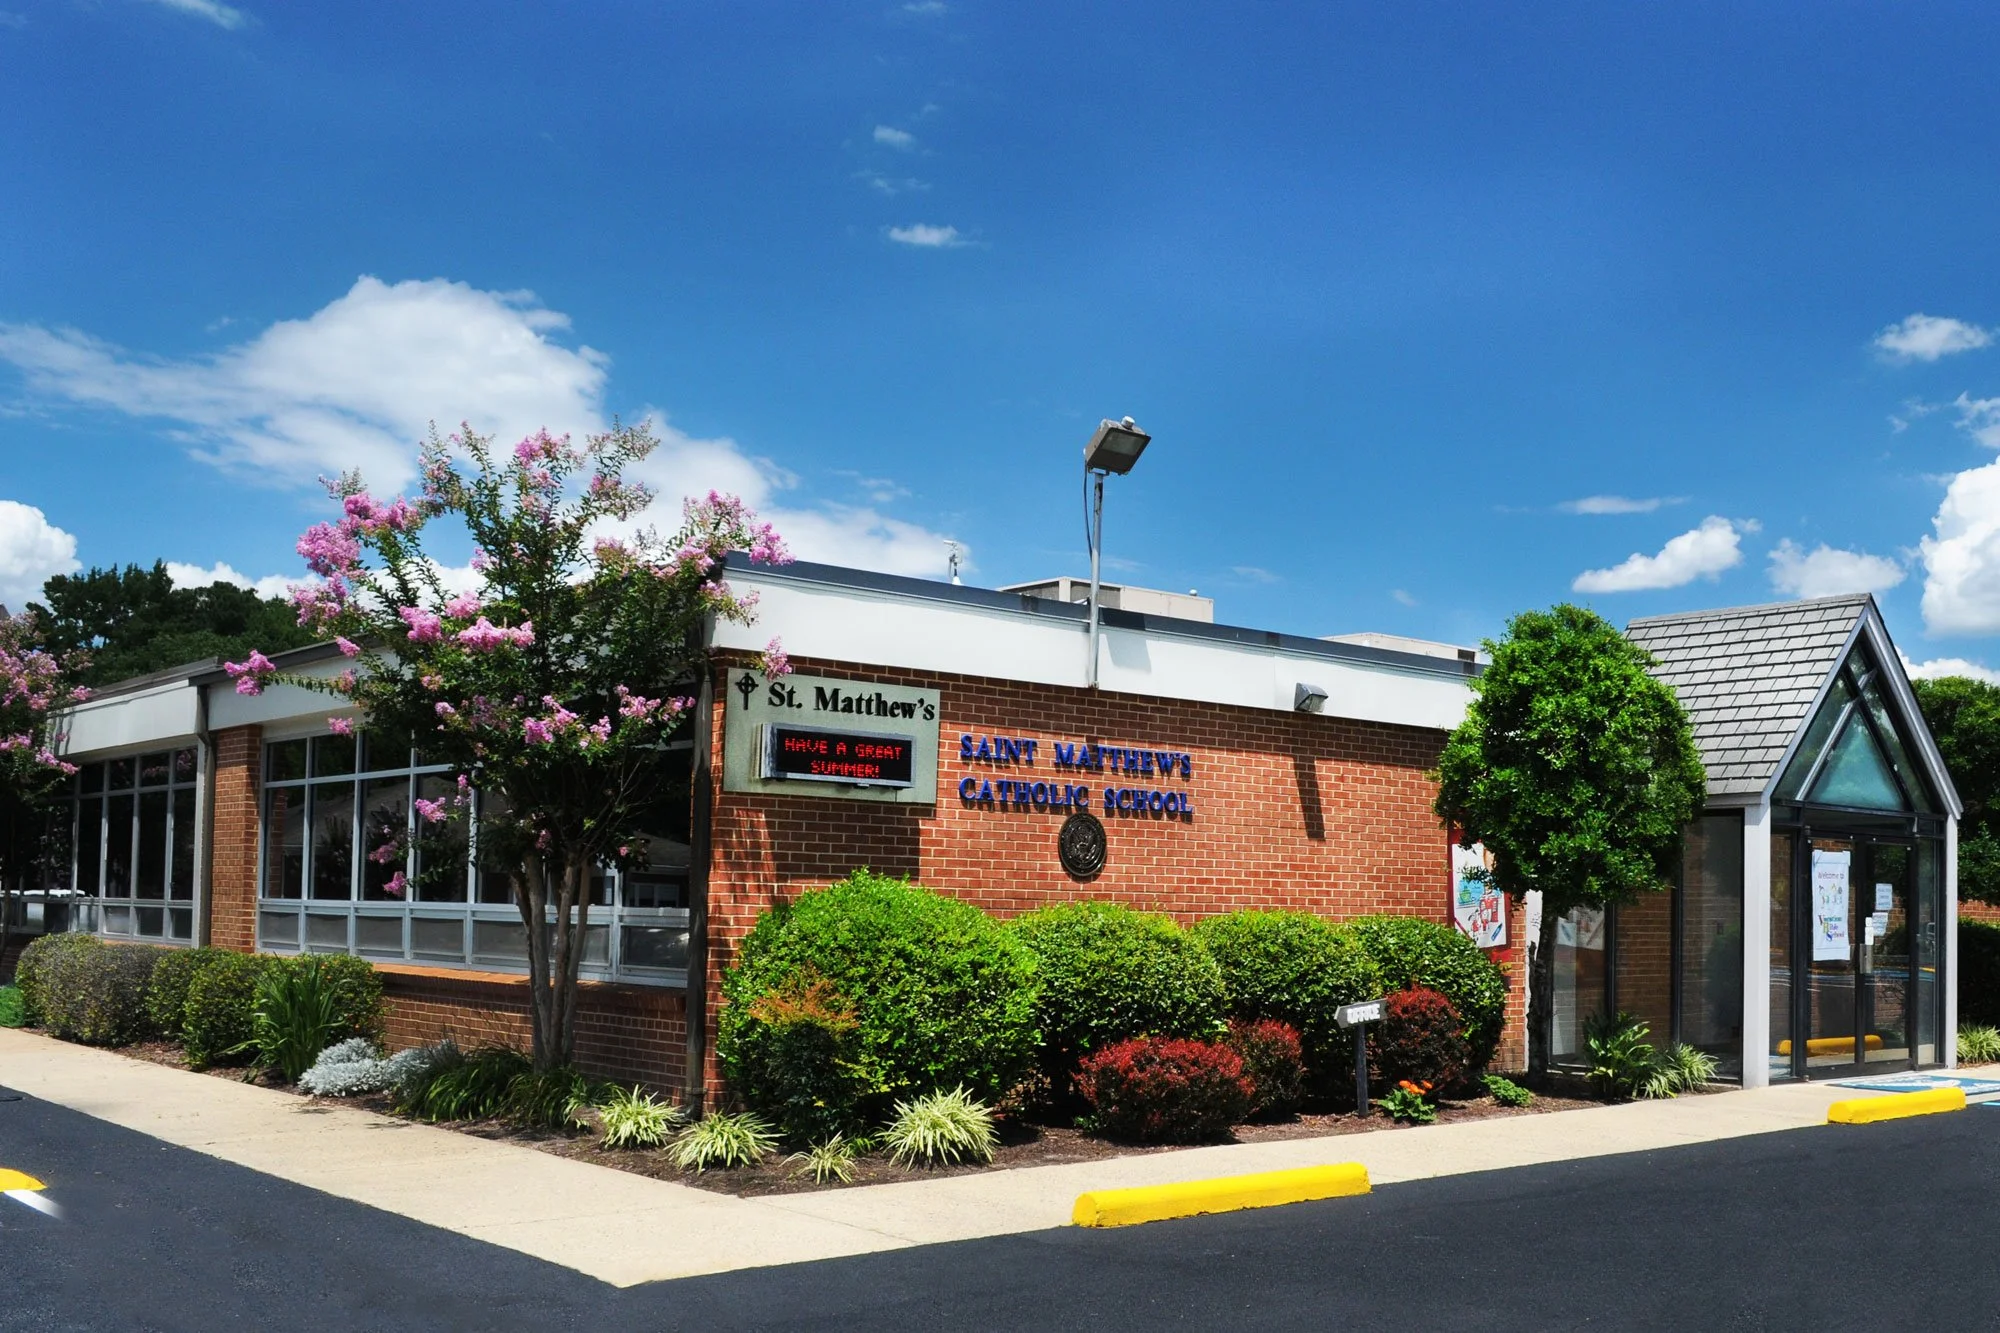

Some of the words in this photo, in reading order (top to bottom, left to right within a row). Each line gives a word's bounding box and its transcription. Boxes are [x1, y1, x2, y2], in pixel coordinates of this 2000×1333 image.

[768, 681, 803, 709] St.
[814, 686, 935, 721] Matthew's
[784, 738, 828, 755] HAVE
[836, 742, 847, 756] A
[854, 743, 902, 760] GREAT
[959, 734, 1038, 762] SAINT
[1053, 741, 1192, 775] MATTHEW'S
[811, 760, 880, 779] SUMMER!
[959, 777, 1089, 807] CATHOLIC
[1104, 787, 1193, 814] SCHOOL
